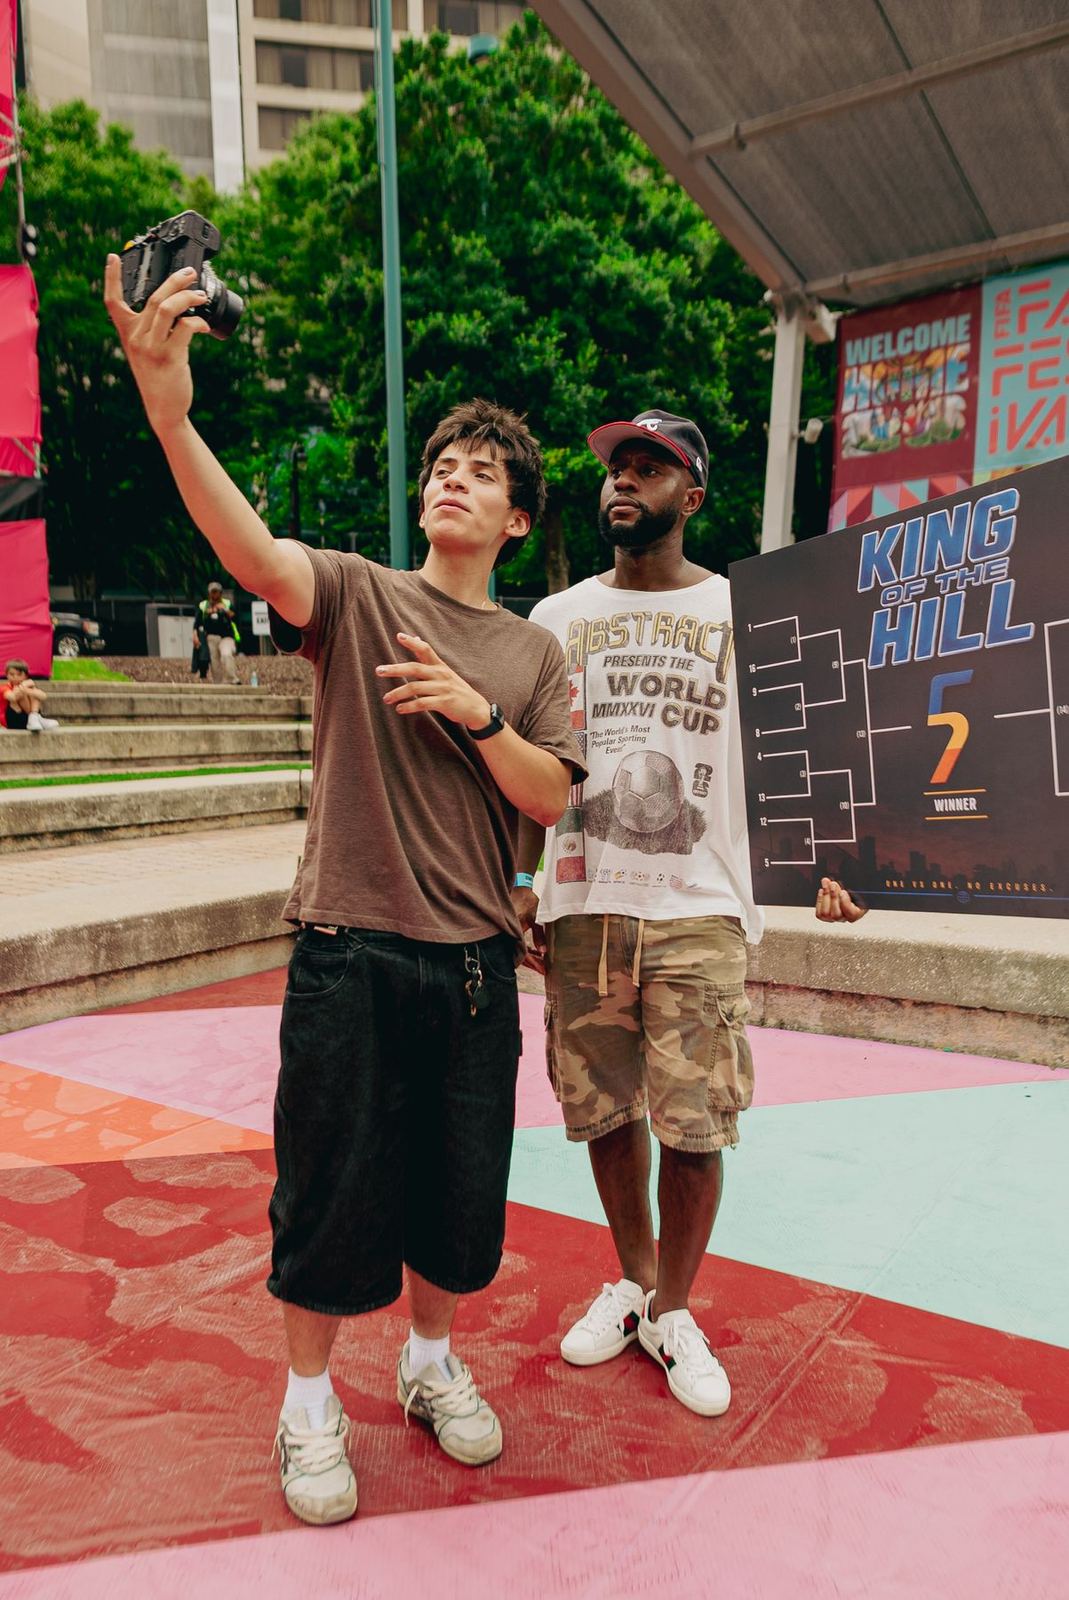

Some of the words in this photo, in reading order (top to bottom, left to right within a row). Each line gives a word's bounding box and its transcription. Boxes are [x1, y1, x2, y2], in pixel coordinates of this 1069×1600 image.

[845, 313, 971, 366] WELCOME
[857, 488, 1020, 593] KING
[880, 578, 927, 607] OF
[935, 557, 1010, 593] THE
[867, 579, 1035, 669] HILL
[603, 655, 667, 669] PRESENTS
[669, 656, 696, 671] THE
[748, 663, 756, 673] 16
[607, 671, 728, 710] WORLD
[752, 687, 757, 697] 9
[592, 702, 658, 719] MMXXVI
[661, 702, 722, 735] CUP
[604, 726, 629, 736] World's
[630, 725, 651, 733] Most
[755, 728, 760, 738] 8
[591, 737, 616, 748] Popular
[618, 734, 647, 744] Sporting
[757, 751, 762, 761] 4
[758, 792, 766, 802] 13
[934, 797, 977, 812] WINNER
[760, 816, 768, 826] 12
[764, 858, 770, 867] 5
